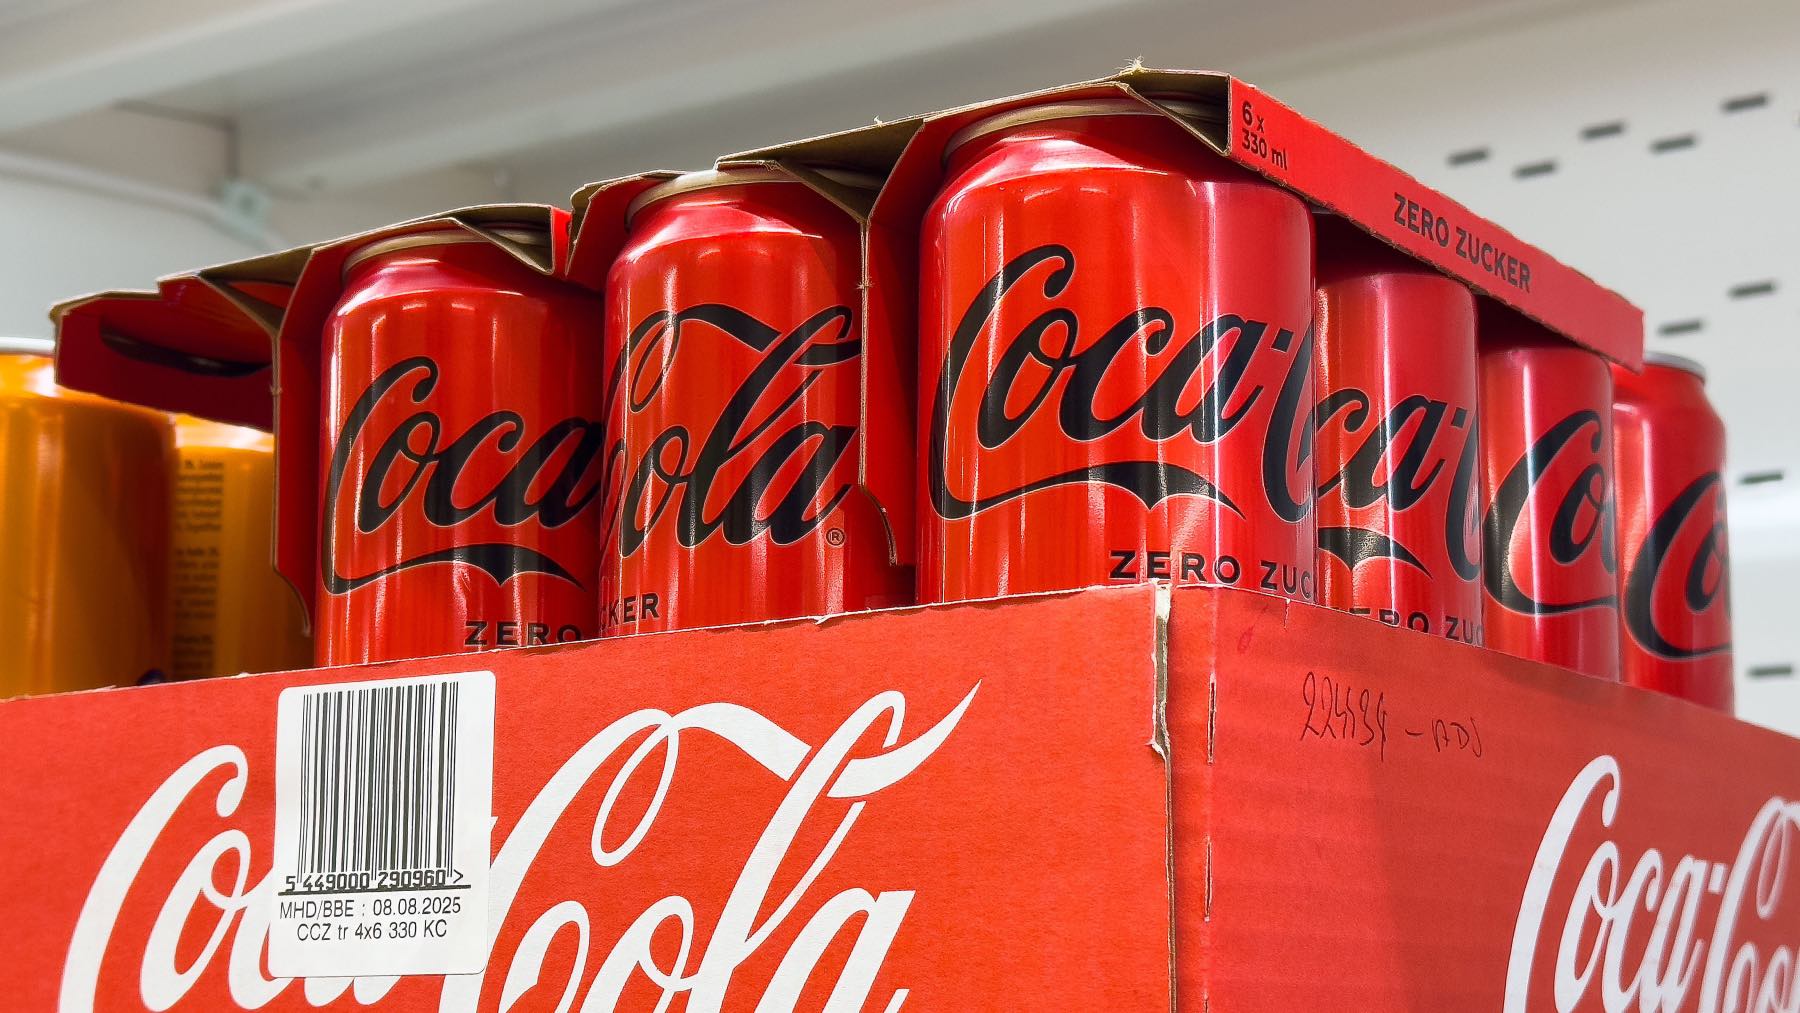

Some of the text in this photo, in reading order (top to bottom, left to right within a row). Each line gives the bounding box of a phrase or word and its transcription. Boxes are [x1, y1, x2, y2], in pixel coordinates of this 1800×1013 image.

[1242, 101, 1253, 126] 6
[1241, 128, 1287, 171] 330 ml
[1394, 192, 1532, 293] ZERO ZUCKER
[1109, 550, 1241, 585] ZERO
[602, 592, 661, 631] KER
[464, 619, 583, 647] ZERO
[285, 875, 297, 893] 5
[302, 872, 371, 892] 449000
[377, 869, 447, 889] 290960
[279, 900, 355, 920] MHD/BBE
[372, 896, 462, 916] 08.08.2025
[297, 919, 448, 941] CCZ tr 4x6 330 KC
